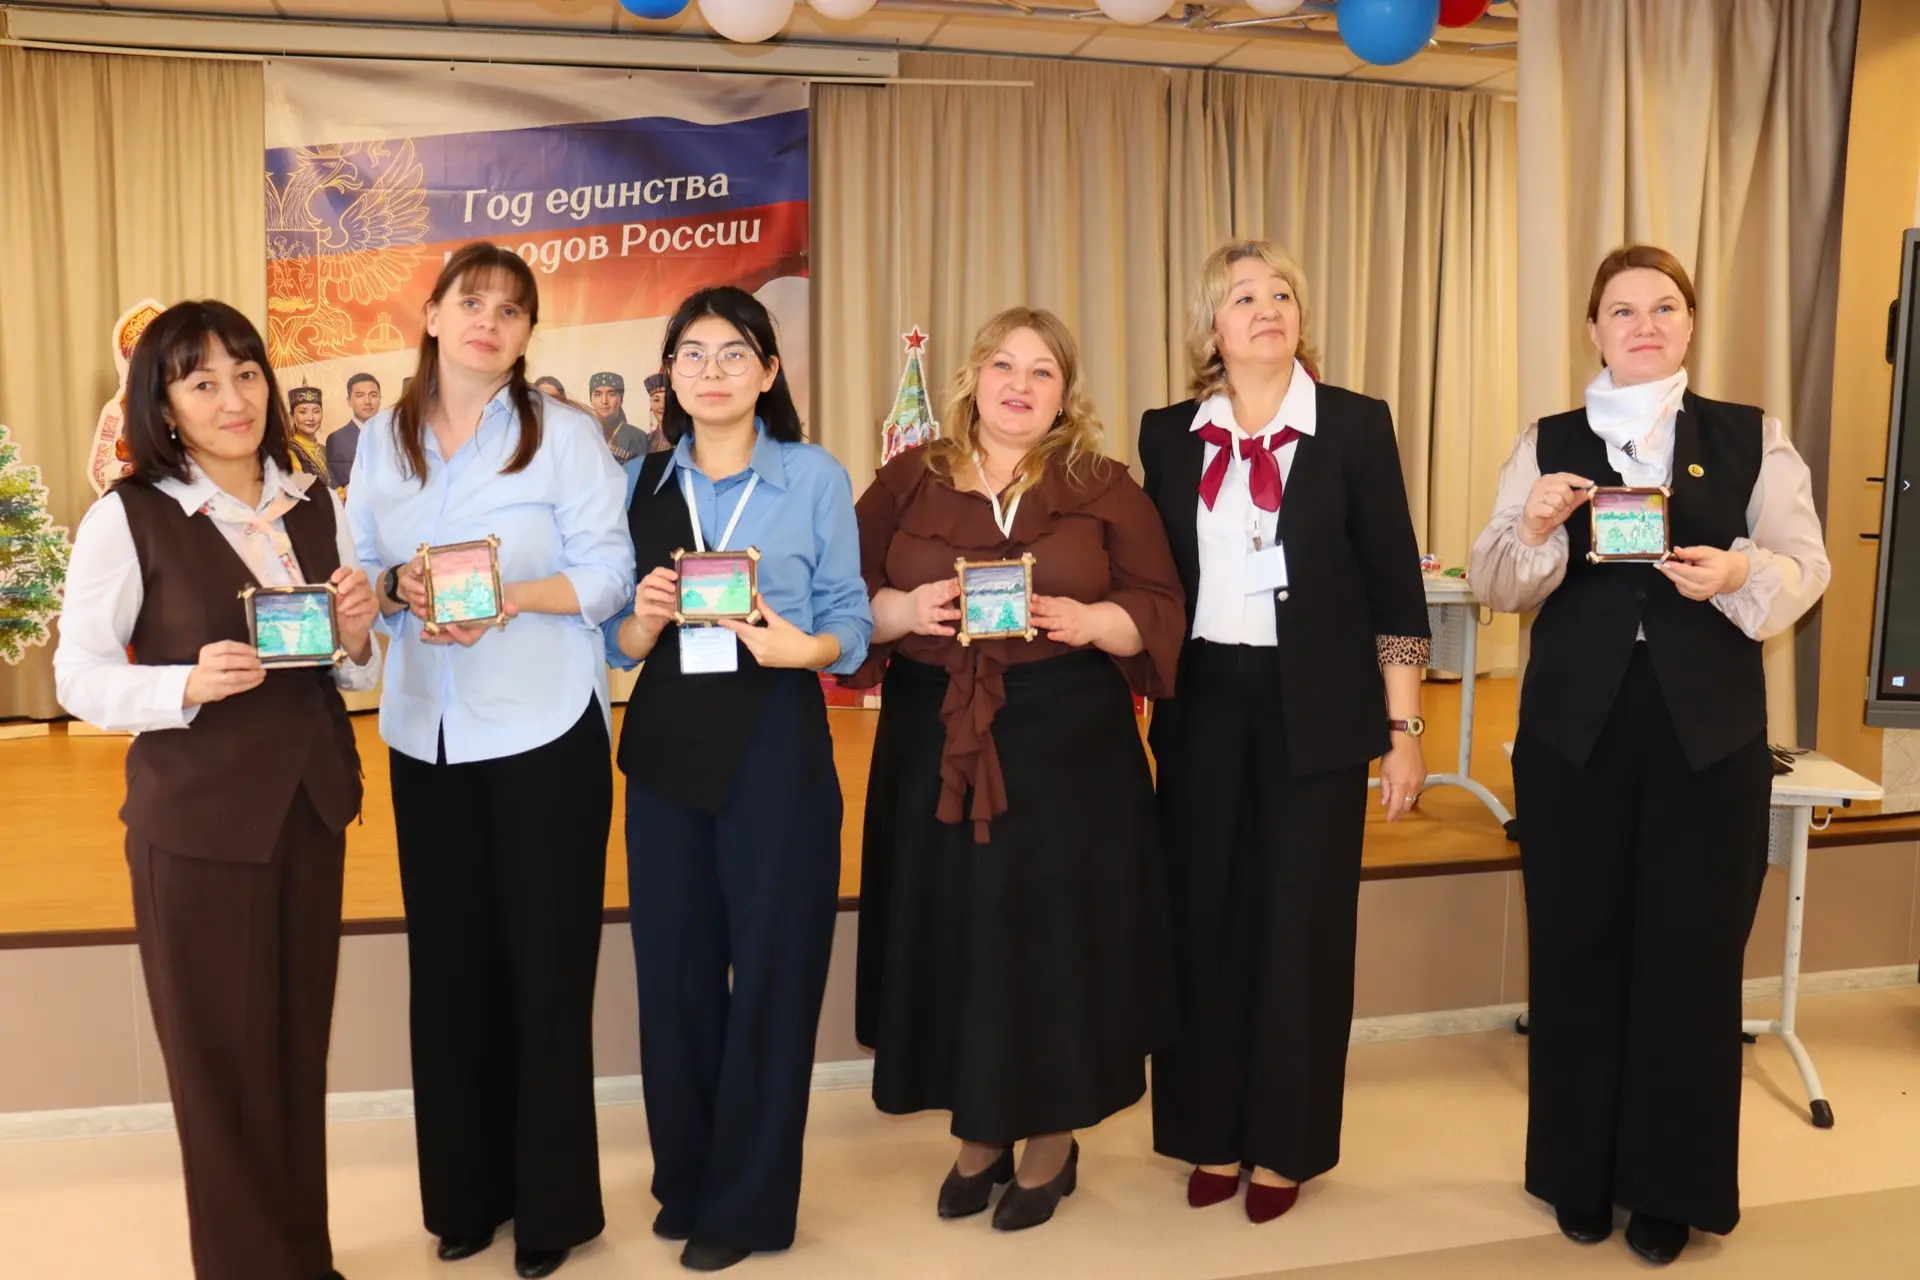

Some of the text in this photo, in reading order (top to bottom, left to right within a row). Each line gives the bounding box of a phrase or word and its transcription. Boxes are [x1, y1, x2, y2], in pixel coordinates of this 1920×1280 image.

[464, 172, 729, 227] Год единства
[444, 218, 761, 274] одов России
